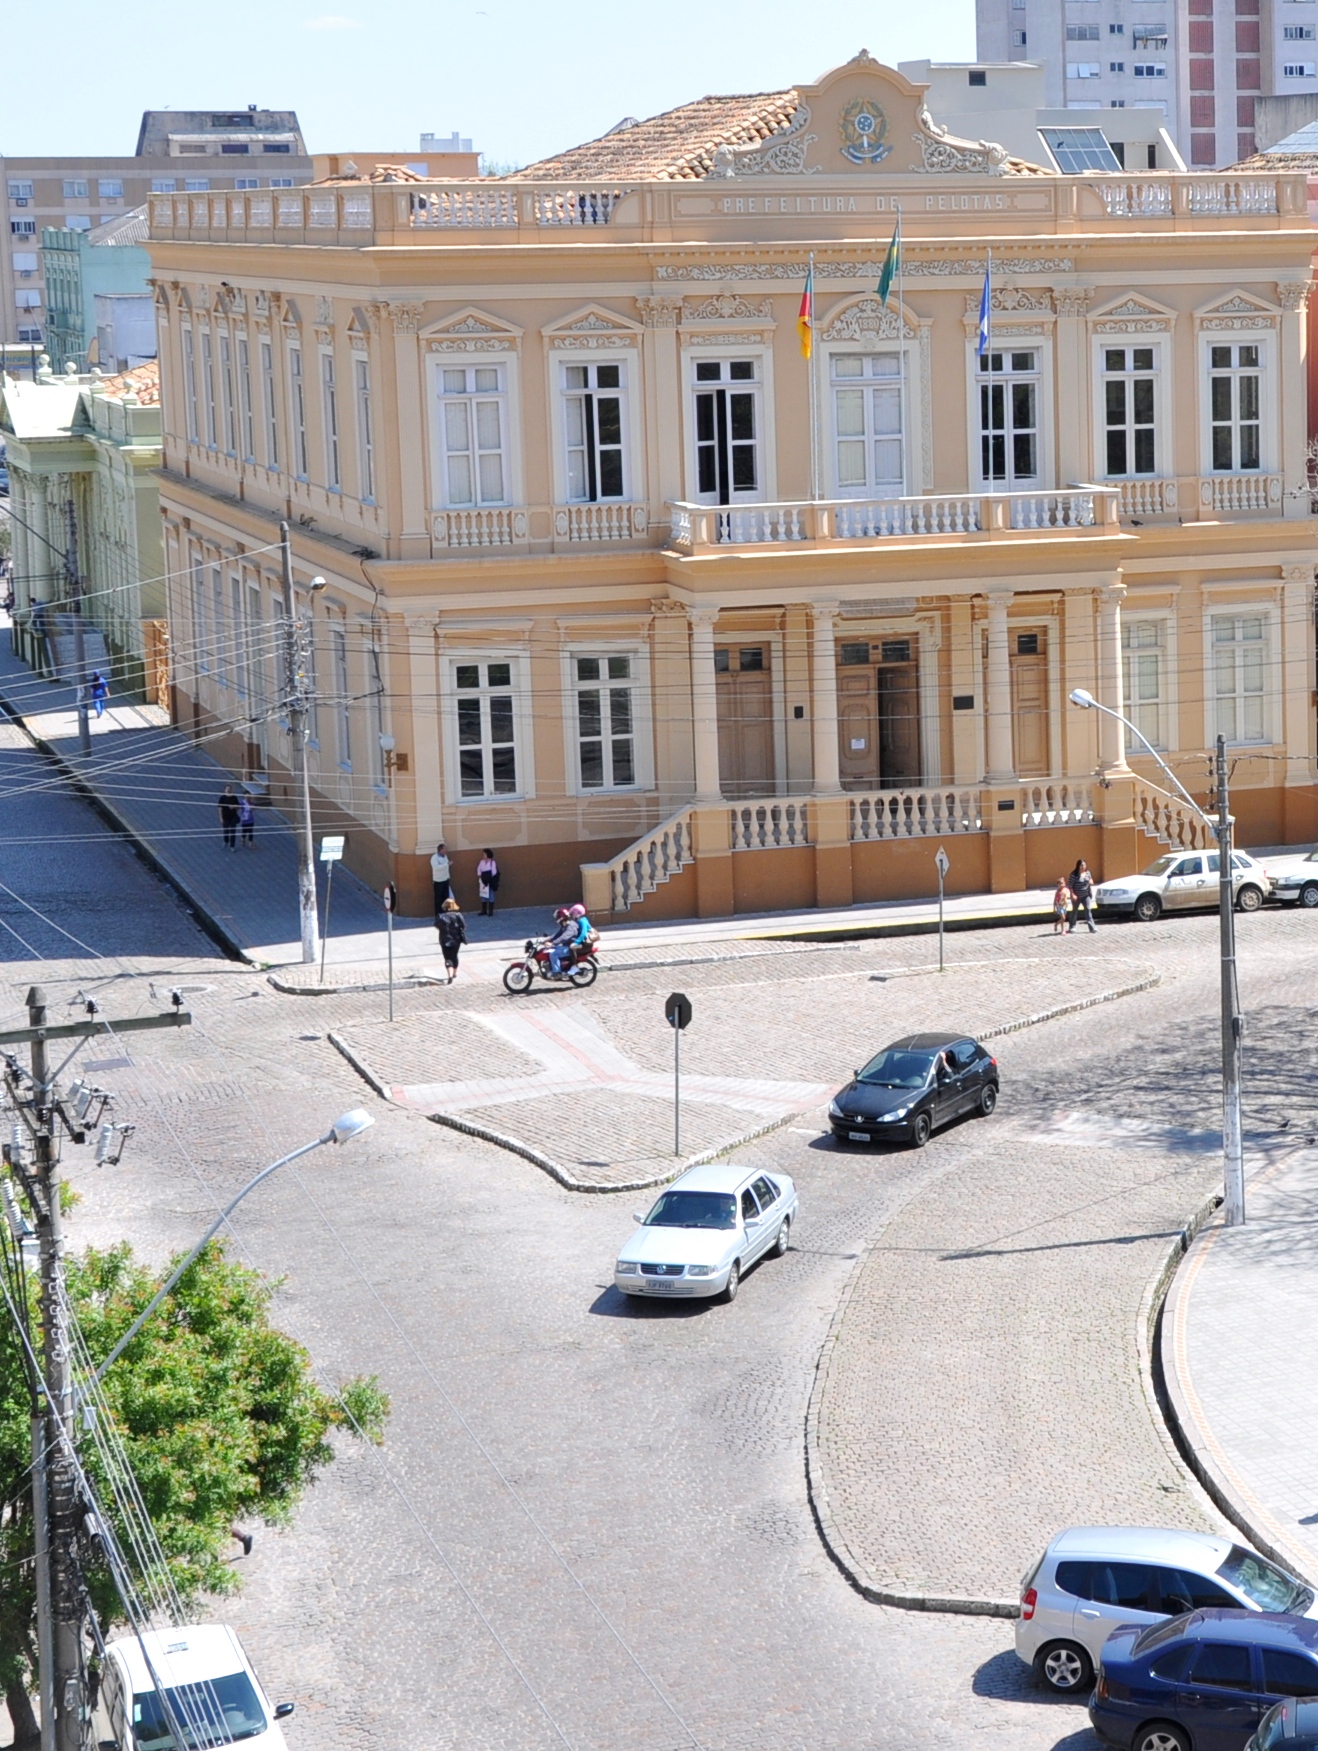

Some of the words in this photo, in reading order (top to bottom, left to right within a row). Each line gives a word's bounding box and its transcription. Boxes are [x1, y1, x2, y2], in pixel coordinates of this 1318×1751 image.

[723, 196, 858, 213] PREFEITURA
[876, 195, 899, 212] DE
[925, 194, 1005, 211] PELOTAS
